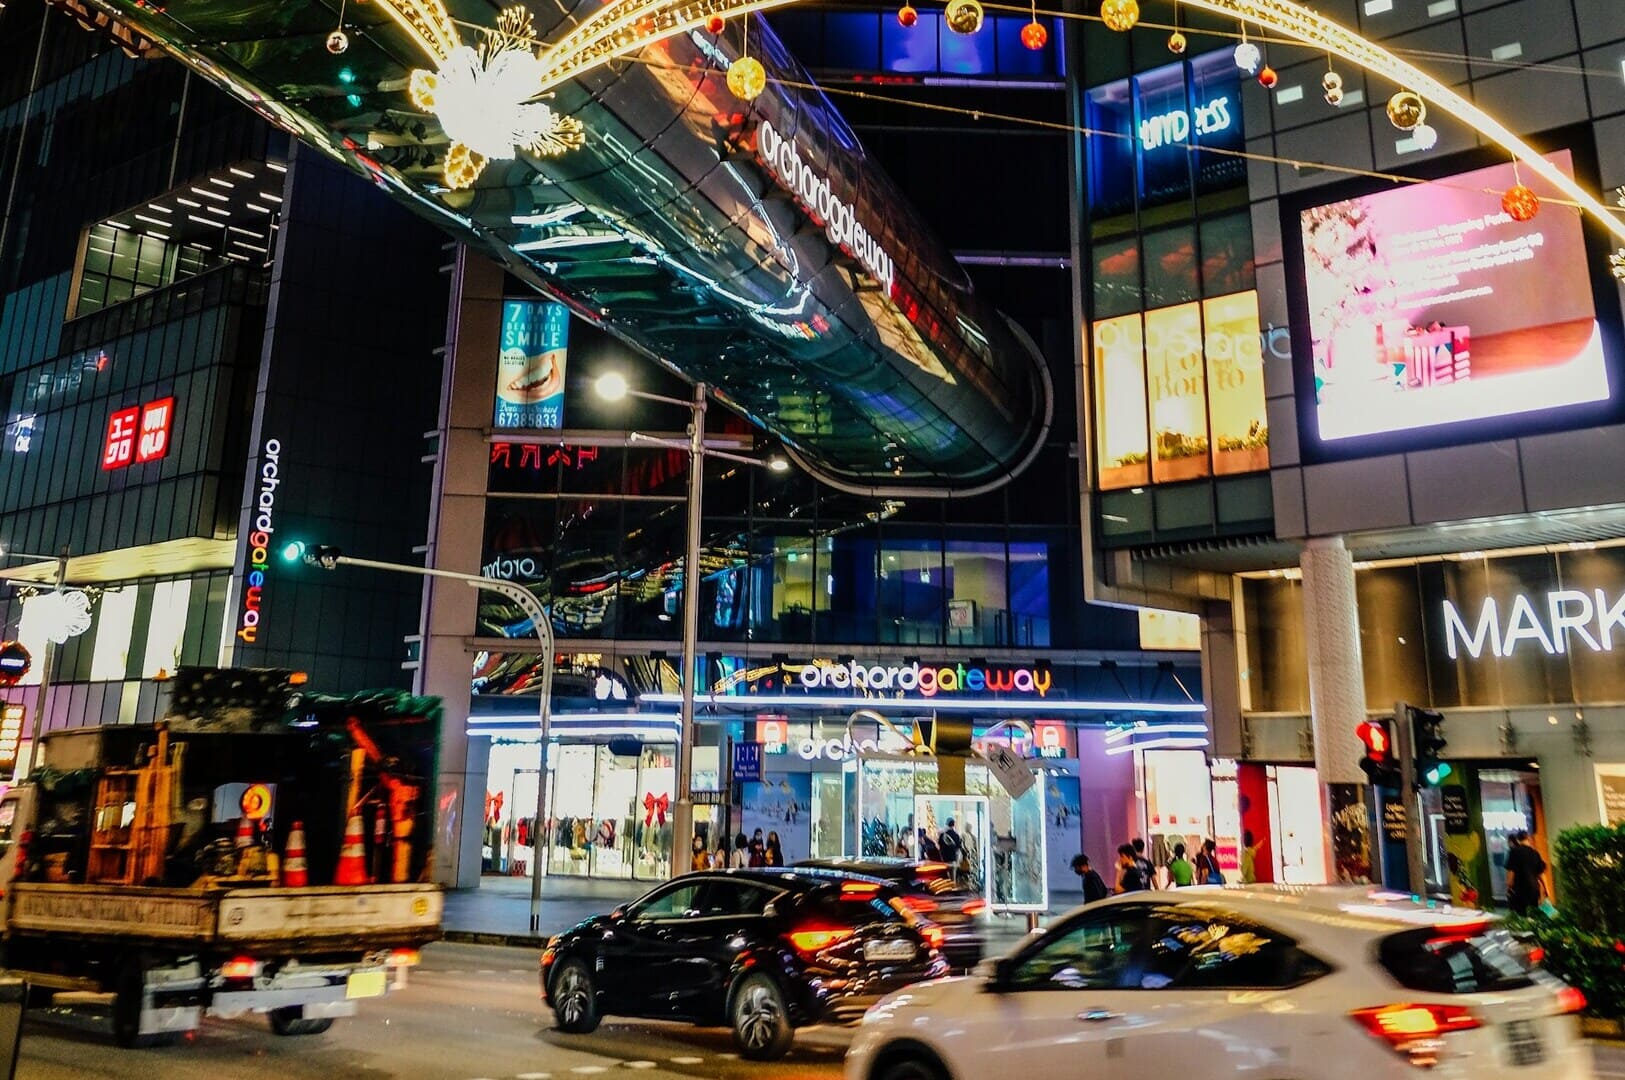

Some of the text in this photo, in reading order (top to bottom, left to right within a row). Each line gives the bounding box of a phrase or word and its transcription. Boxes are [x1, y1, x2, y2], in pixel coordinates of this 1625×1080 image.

[758, 120, 894, 297] orchardgateway
[506, 322, 561, 332] BEAUTIFUL
[509, 304, 563, 322] 7 DAYS
[505, 331, 561, 347] SMILE
[237, 438, 281, 643] orchardgateway
[1442, 588, 1625, 660] MARK
[799, 659, 1051, 697] orchardgateway
